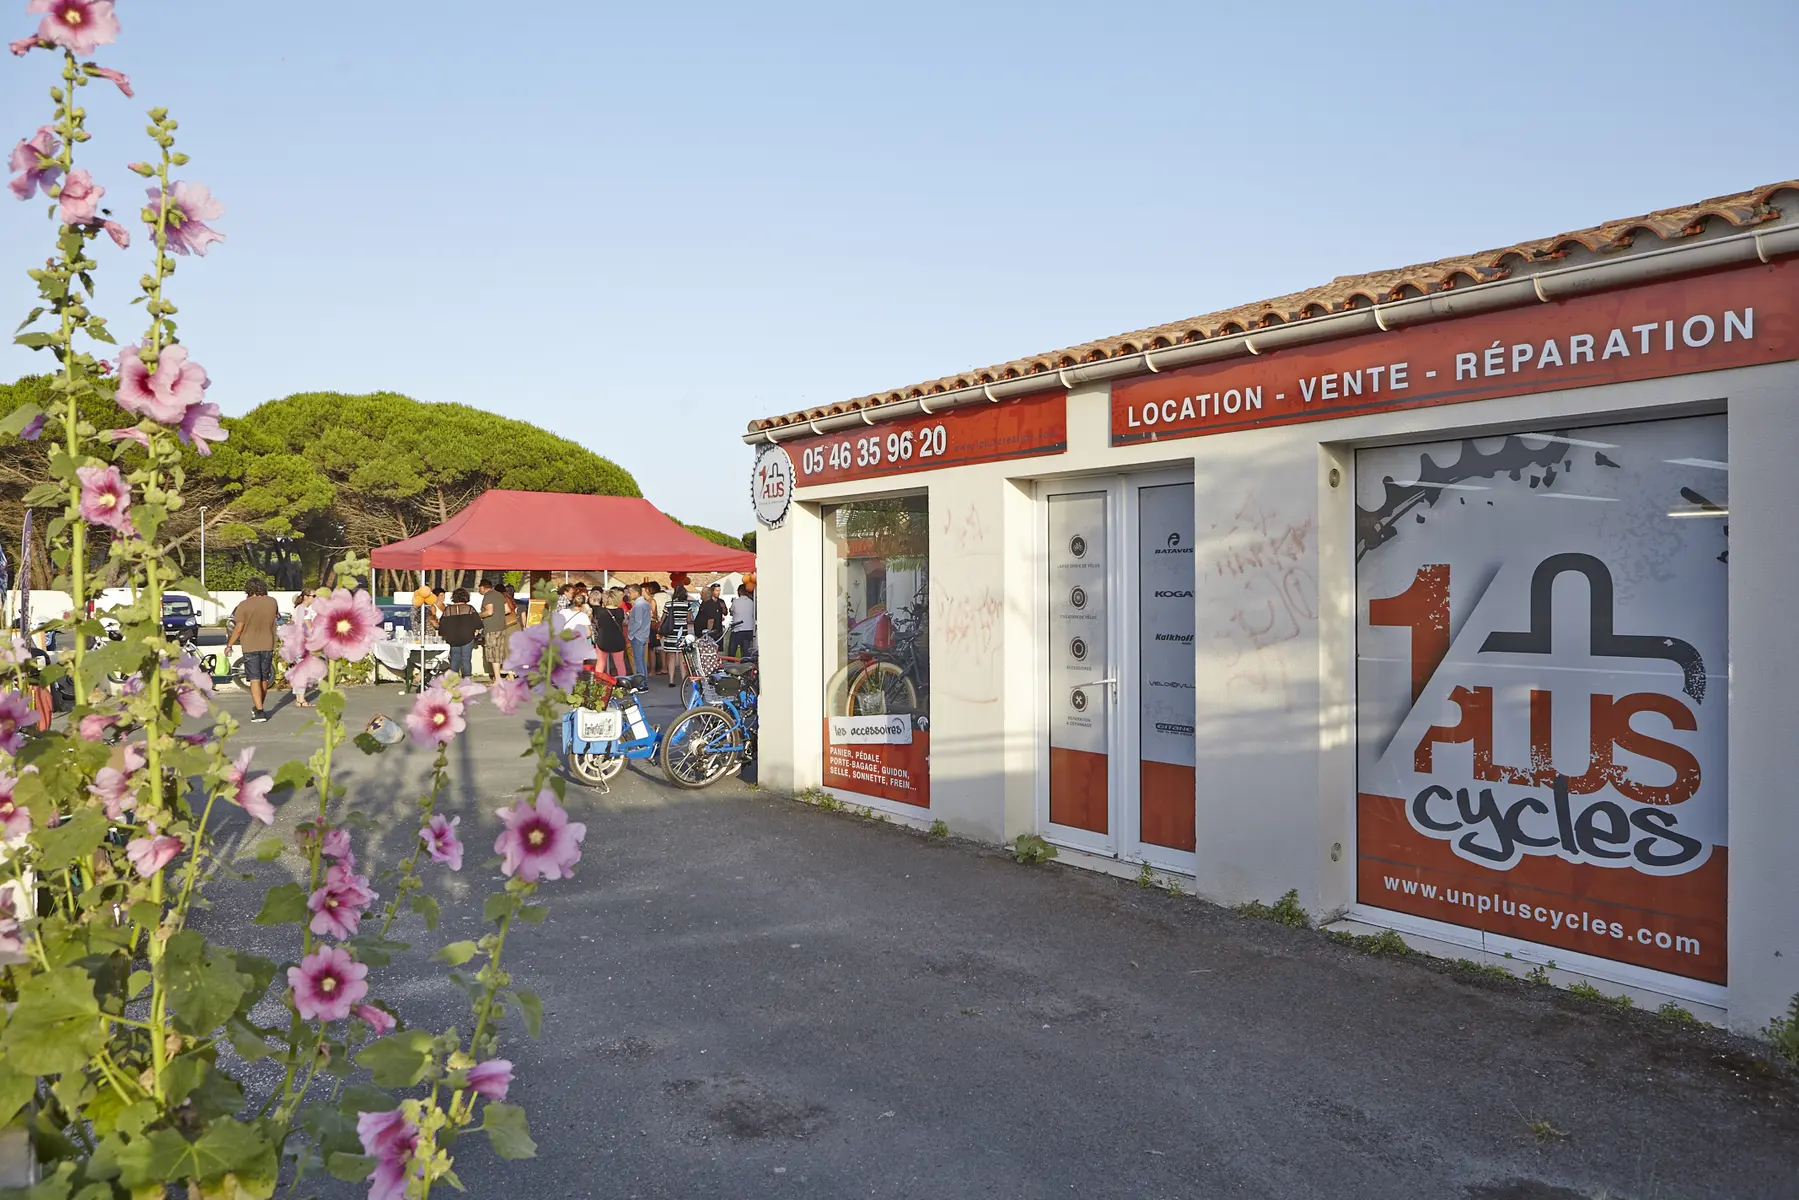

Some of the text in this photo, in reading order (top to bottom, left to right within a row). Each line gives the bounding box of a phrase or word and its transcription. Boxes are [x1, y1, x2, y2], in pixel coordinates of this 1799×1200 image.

[1128, 385, 1262, 428] LOCATION
[1299, 362, 1409, 402] VENTE
[1455, 307, 1754, 381] RÉPARATION
[802, 424, 947, 475] 05 46 35 96 20
[1154, 590, 1194, 598] KOGA
[1155, 633, 1195, 642] Kalkhoff
[834, 724, 902, 736] les accessoires
[829, 747, 882, 764] PANIER, PÉDALE,
[1413, 684, 1702, 806] PLUS
[829, 757, 910, 780] PORTE-BAGAGE, GUIDON,
[829, 767, 917, 791] SELLE, SONNETTE, FREIN...
[1412, 773, 1702, 867] cycles
[1383, 875, 1701, 955] www.unpluscycles.com
